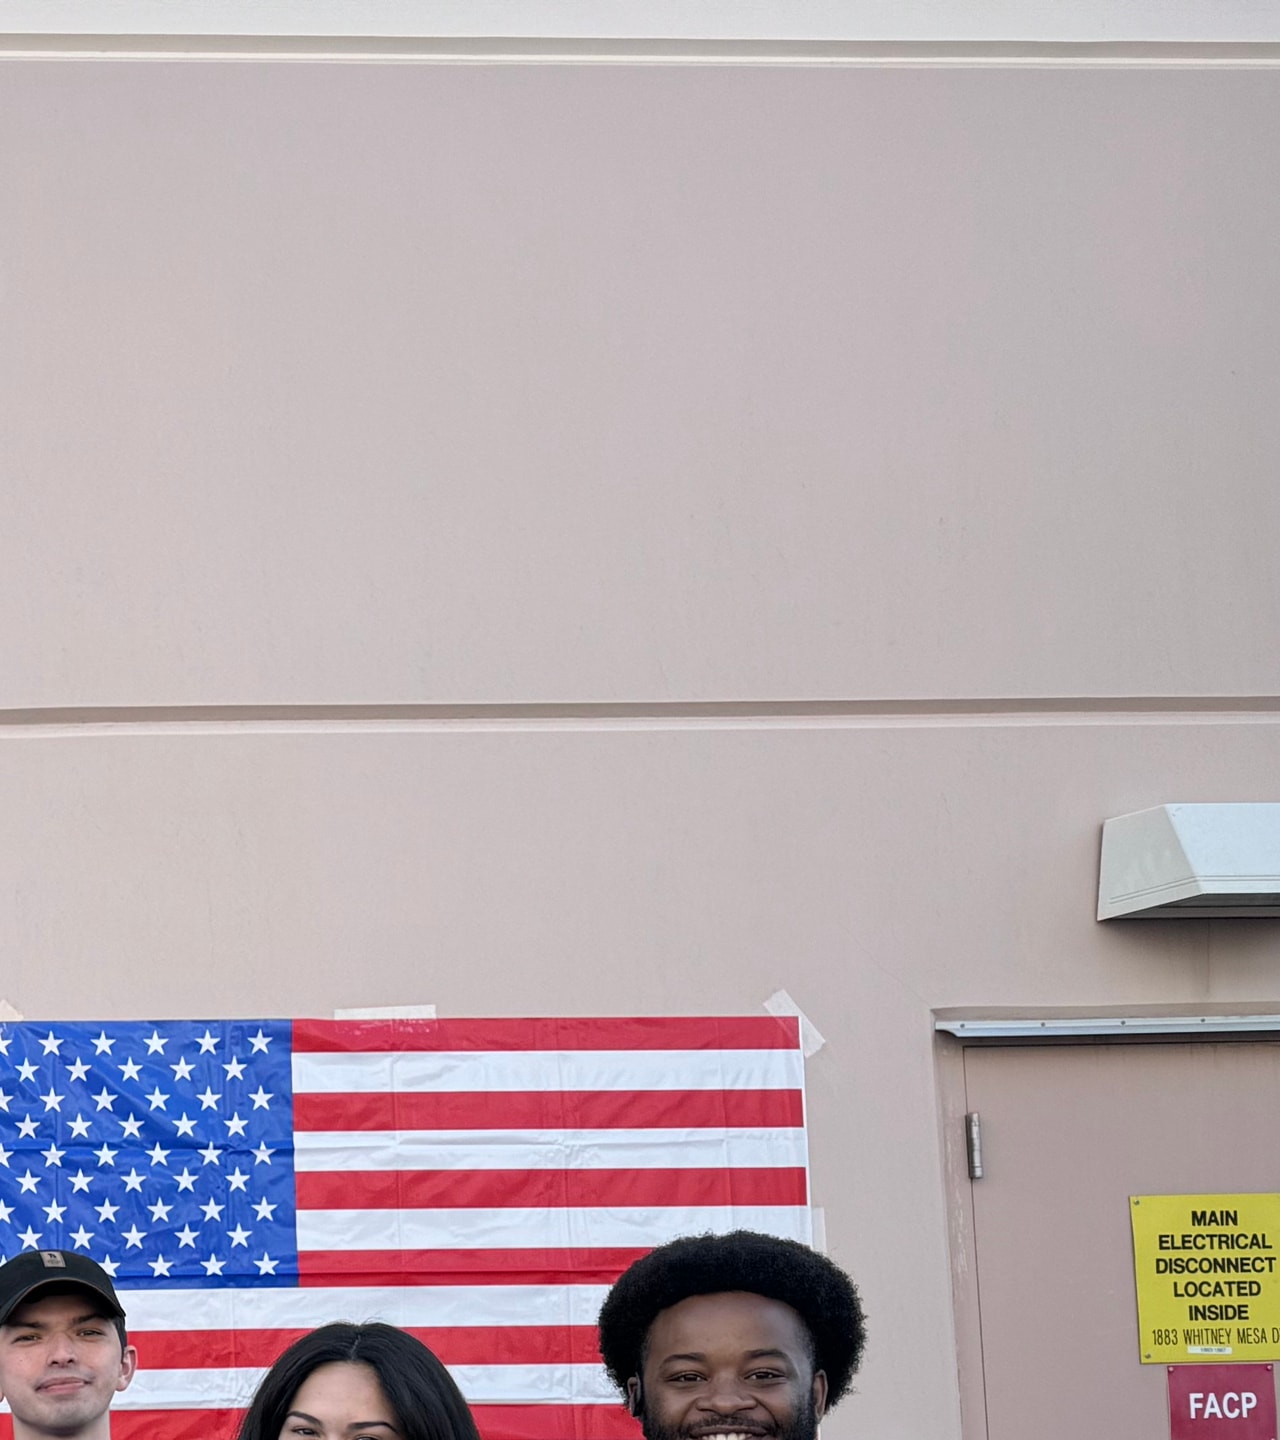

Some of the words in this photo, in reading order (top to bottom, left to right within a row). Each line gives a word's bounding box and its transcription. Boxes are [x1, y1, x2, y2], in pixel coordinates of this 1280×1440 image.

[1191, 1210, 1238, 1226] MAIN
[1158, 1233, 1273, 1250] ELECTRICAL
[1155, 1257, 1277, 1274] DISCONNECT
[1173, 1281, 1261, 1298] LOCATED
[1188, 1304, 1249, 1321] INSIDE
[1152, 1328, 1178, 1345] 1883
[1183, 1328, 1232, 1345] WHITNEY
[1237, 1327, 1268, 1344] MESA
[1272, 1327, 1280, 1344] D
[1189, 1391, 1258, 1419] FACP
